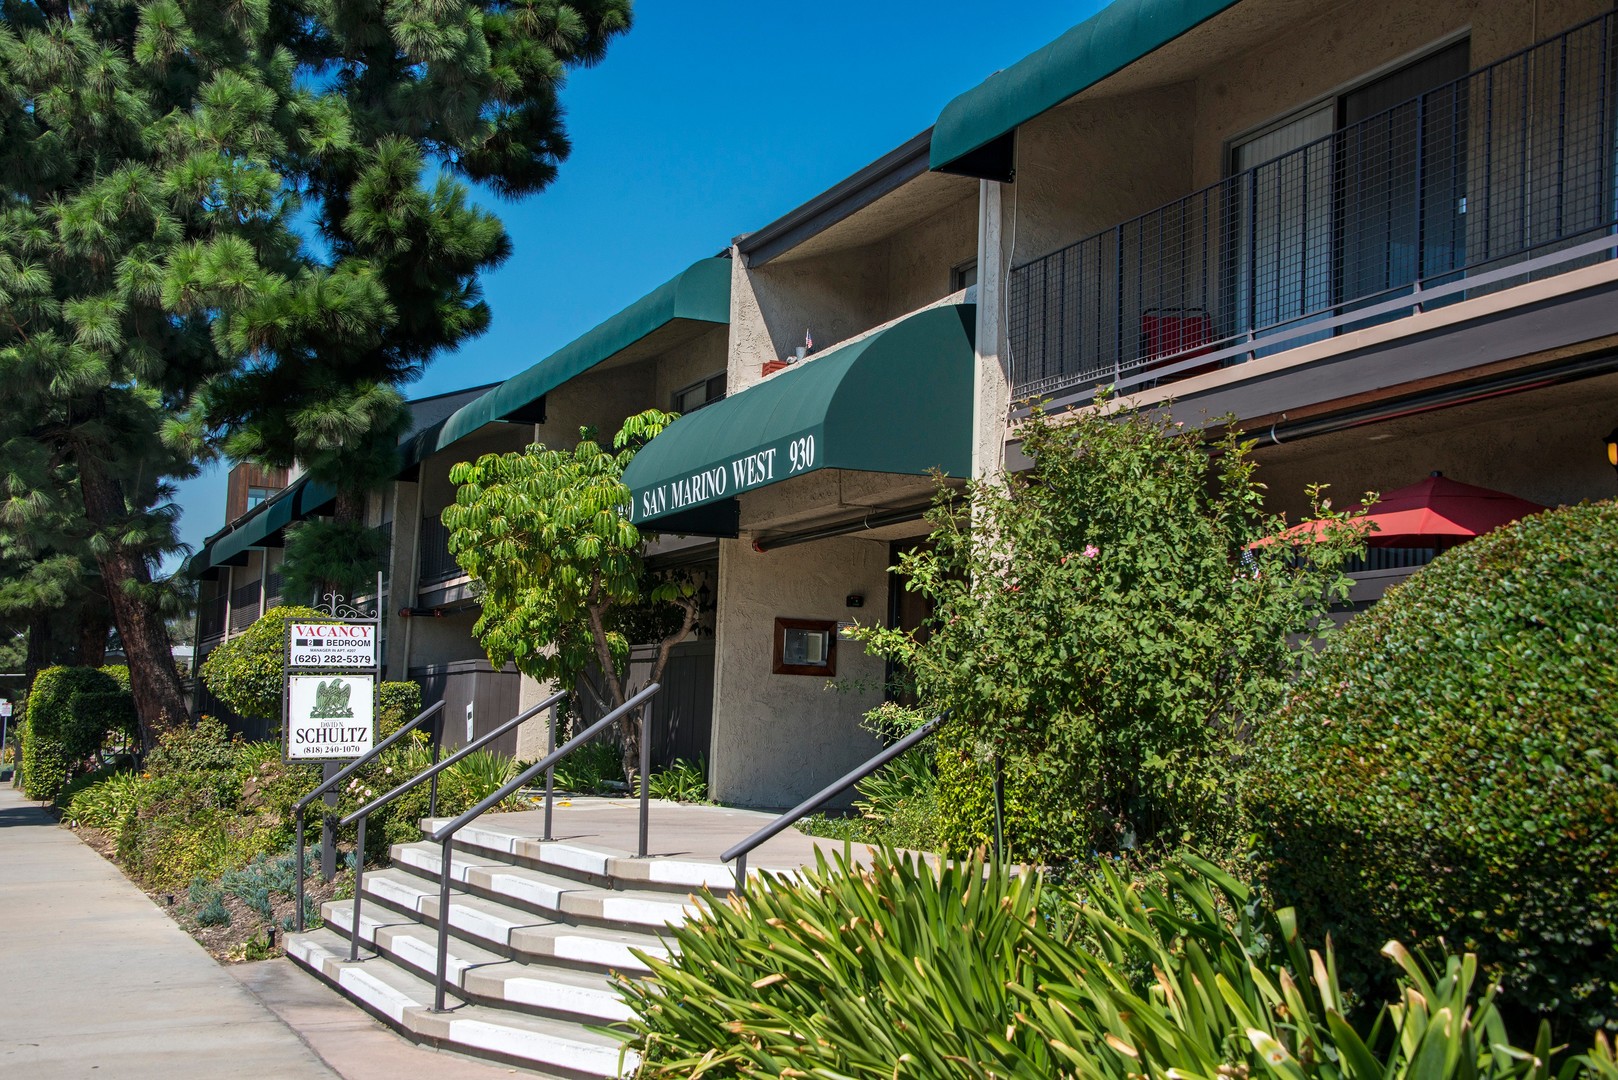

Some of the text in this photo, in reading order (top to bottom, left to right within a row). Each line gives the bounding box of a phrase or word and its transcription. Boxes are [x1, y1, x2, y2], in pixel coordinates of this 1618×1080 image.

[642, 485, 667, 518] SAN
[671, 465, 727, 510] MARINO
[731, 448, 776, 490] WEST
[789, 434, 815, 474] 930
[296, 625, 371, 638] VACANCY
[326, 639, 371, 647] BEDROOM
[294, 654, 371, 665] (626) 282-5379
[295, 727, 368, 744] SCHULTZ
[324, 745, 361, 754] 240-1070
